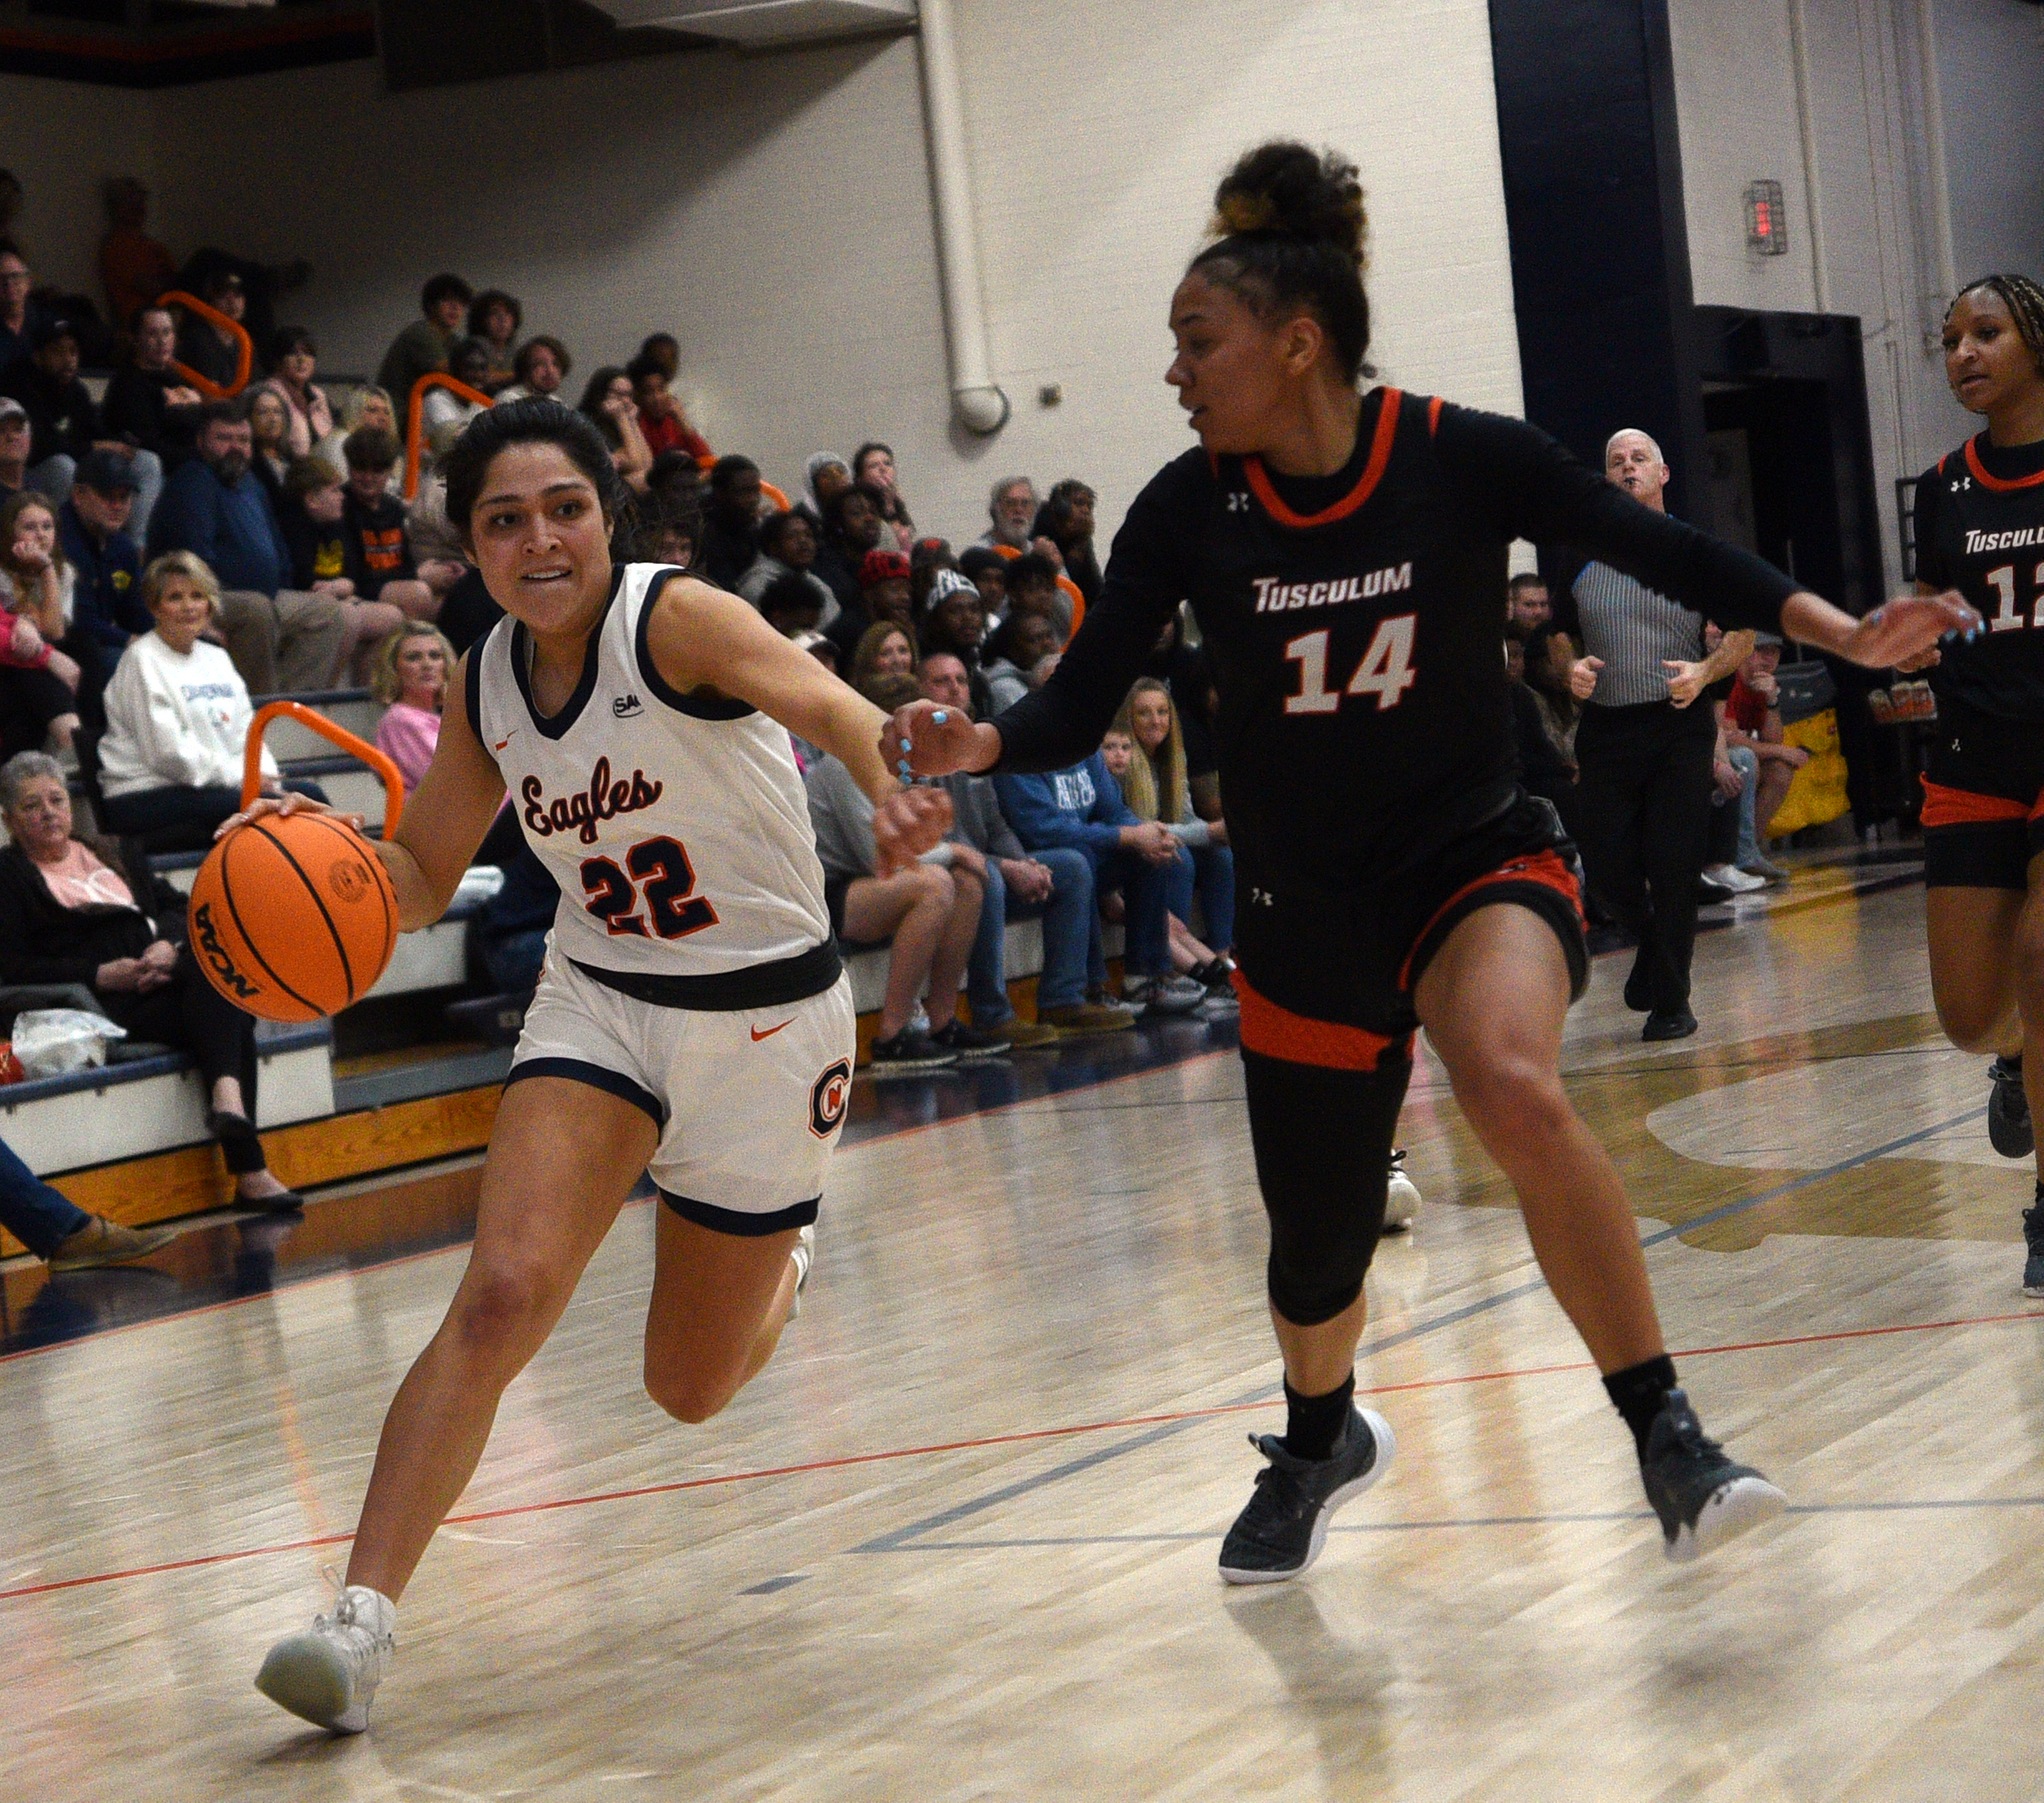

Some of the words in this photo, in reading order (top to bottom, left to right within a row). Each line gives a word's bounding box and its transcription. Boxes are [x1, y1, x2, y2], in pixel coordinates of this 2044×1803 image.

[1252, 561, 1413, 613] TUSCULUM
[1283, 611, 1418, 715] 14
[521, 755, 664, 845] Eagles
[579, 835, 720, 941] 22
[195, 902, 261, 999] NCAA
